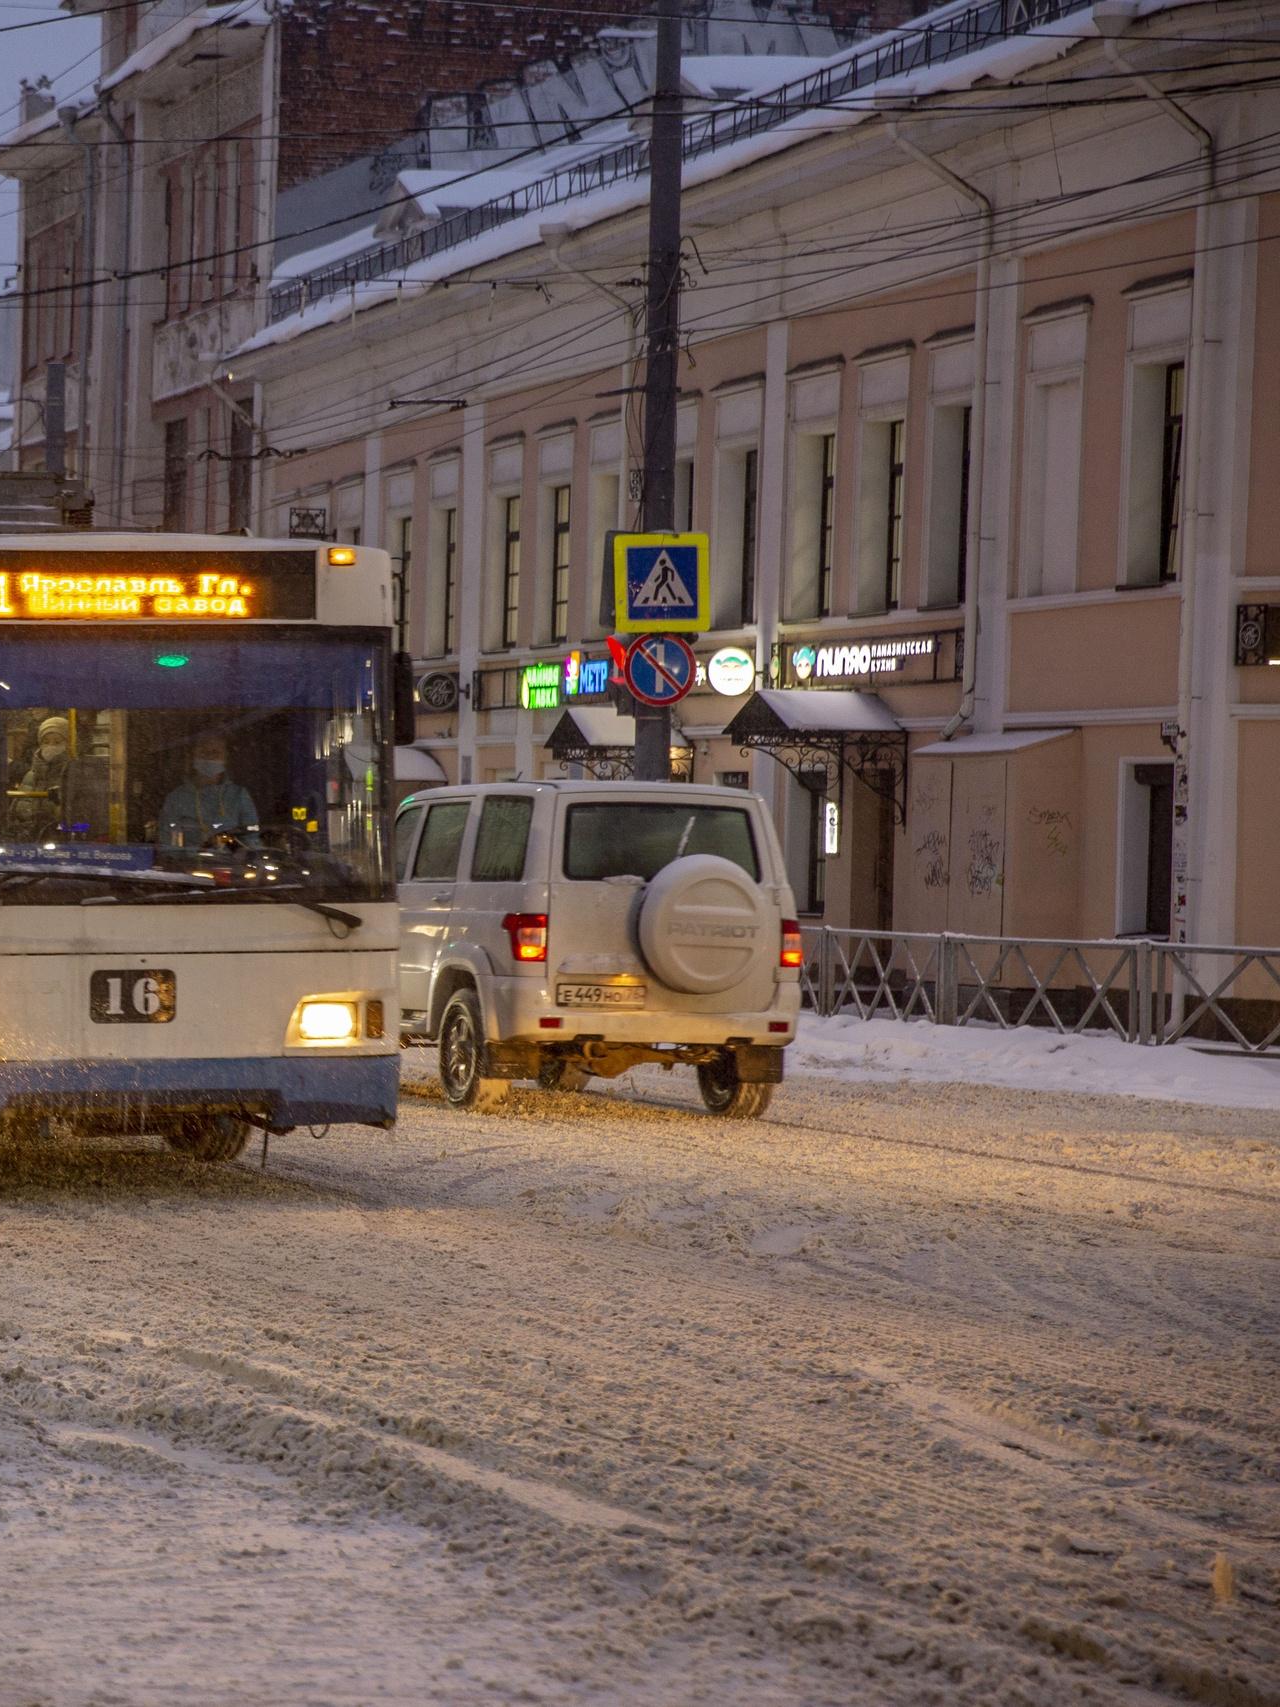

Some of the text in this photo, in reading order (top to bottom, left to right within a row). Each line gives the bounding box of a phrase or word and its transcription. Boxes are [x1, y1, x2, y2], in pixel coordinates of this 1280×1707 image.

[21, 573, 250, 594] Ярославль Гл.
[156, 595, 247, 615] завод
[871, 639, 933, 658] ПАНАЗИАТСКАЯ
[526, 662, 560, 687] ЧАЙНАЯ
[870, 657, 896, 673] КУХНЯ
[528, 686, 558, 708] ЛАВКА
[667, 921, 760, 938] PATRIOT
[105, 977, 160, 1015] 16
